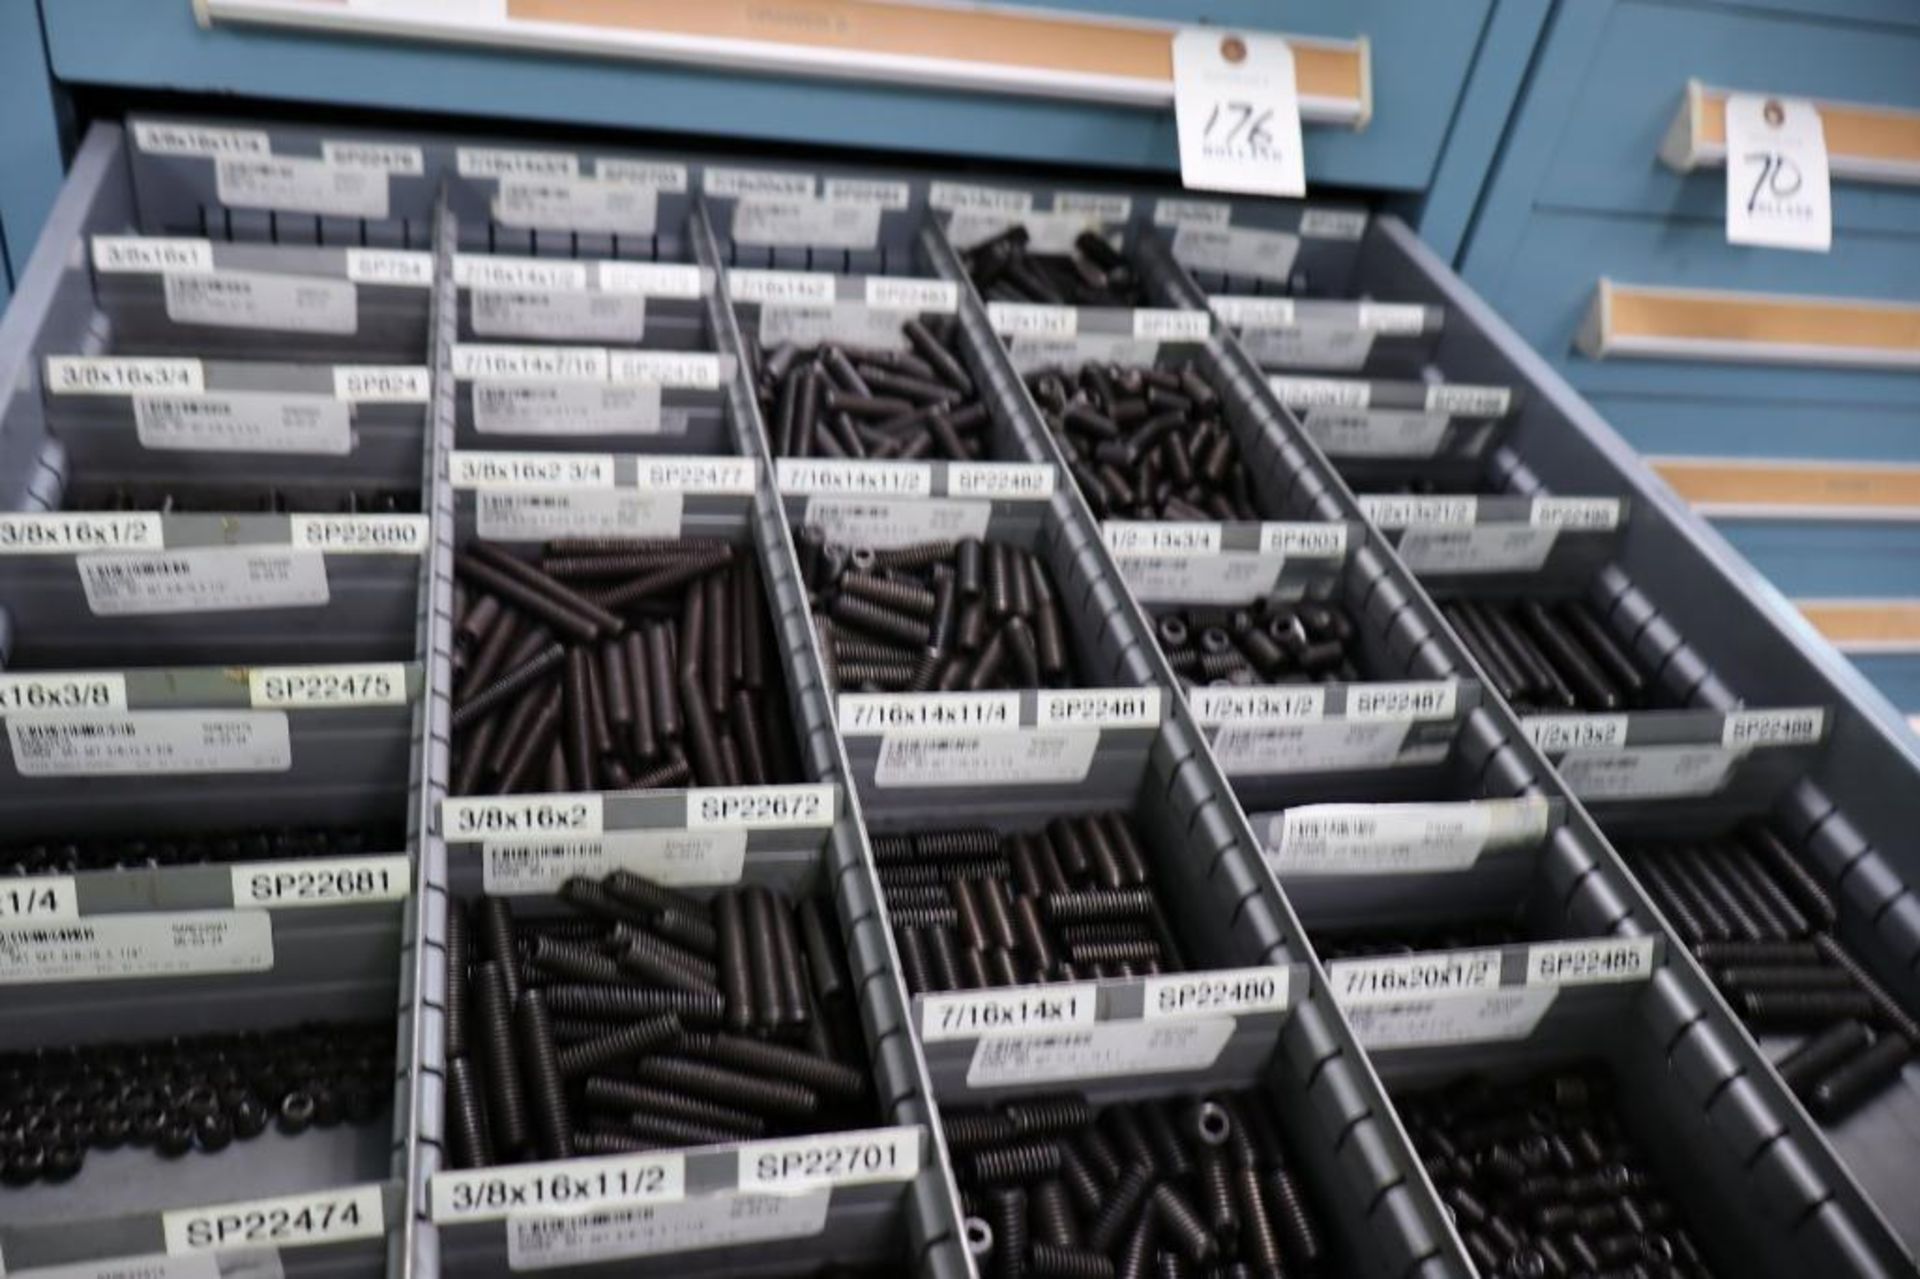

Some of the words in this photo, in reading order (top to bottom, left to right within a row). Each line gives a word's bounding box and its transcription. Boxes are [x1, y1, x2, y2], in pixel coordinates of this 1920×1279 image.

[1203, 101, 1274, 147] 176
[1744, 153, 1802, 212] 70
[108, 244, 200, 265] 3/8x16x1
[62, 363, 191, 386] 3/8x16x3/4
[466, 356, 596, 375] 7/16x14x7/16
[461, 460, 562, 482] 3/8x16x2
[566, 461, 602, 482] 3/4
[649, 466, 746, 487] SP22477
[790, 465, 921, 489] 7/16x14x11/2
[959, 470, 1044, 491] SP22482
[1, 522, 148, 544] 3/8x16x1/2
[306, 523, 418, 544] SP22680
[1271, 531, 1340, 550] SP4003
[265, 672, 392, 700] SP22475
[852, 699, 1008, 725] 7/16x14x11/4
[1049, 698, 1147, 721] SP22481
[1202, 693, 1313, 717] 1/2x13x1/2
[1357, 692, 1446, 712] SP22487
[1534, 723, 1617, 744] 1/2x13x2
[458, 806, 589, 831] 3/8x16x2
[701, 795, 821, 821] SP22672
[251, 868, 391, 899] SP22681
[1539, 951, 1642, 976] SP22485
[1345, 963, 1487, 994] 7/16x20x1/2
[1158, 977, 1276, 1013] SP22480
[938, 998, 1078, 1029] 7/16x14x1
[757, 1150, 898, 1182] SP22701
[452, 1167, 666, 1210] 3/8x16x11/2
[186, 1202, 363, 1248] SP22474
